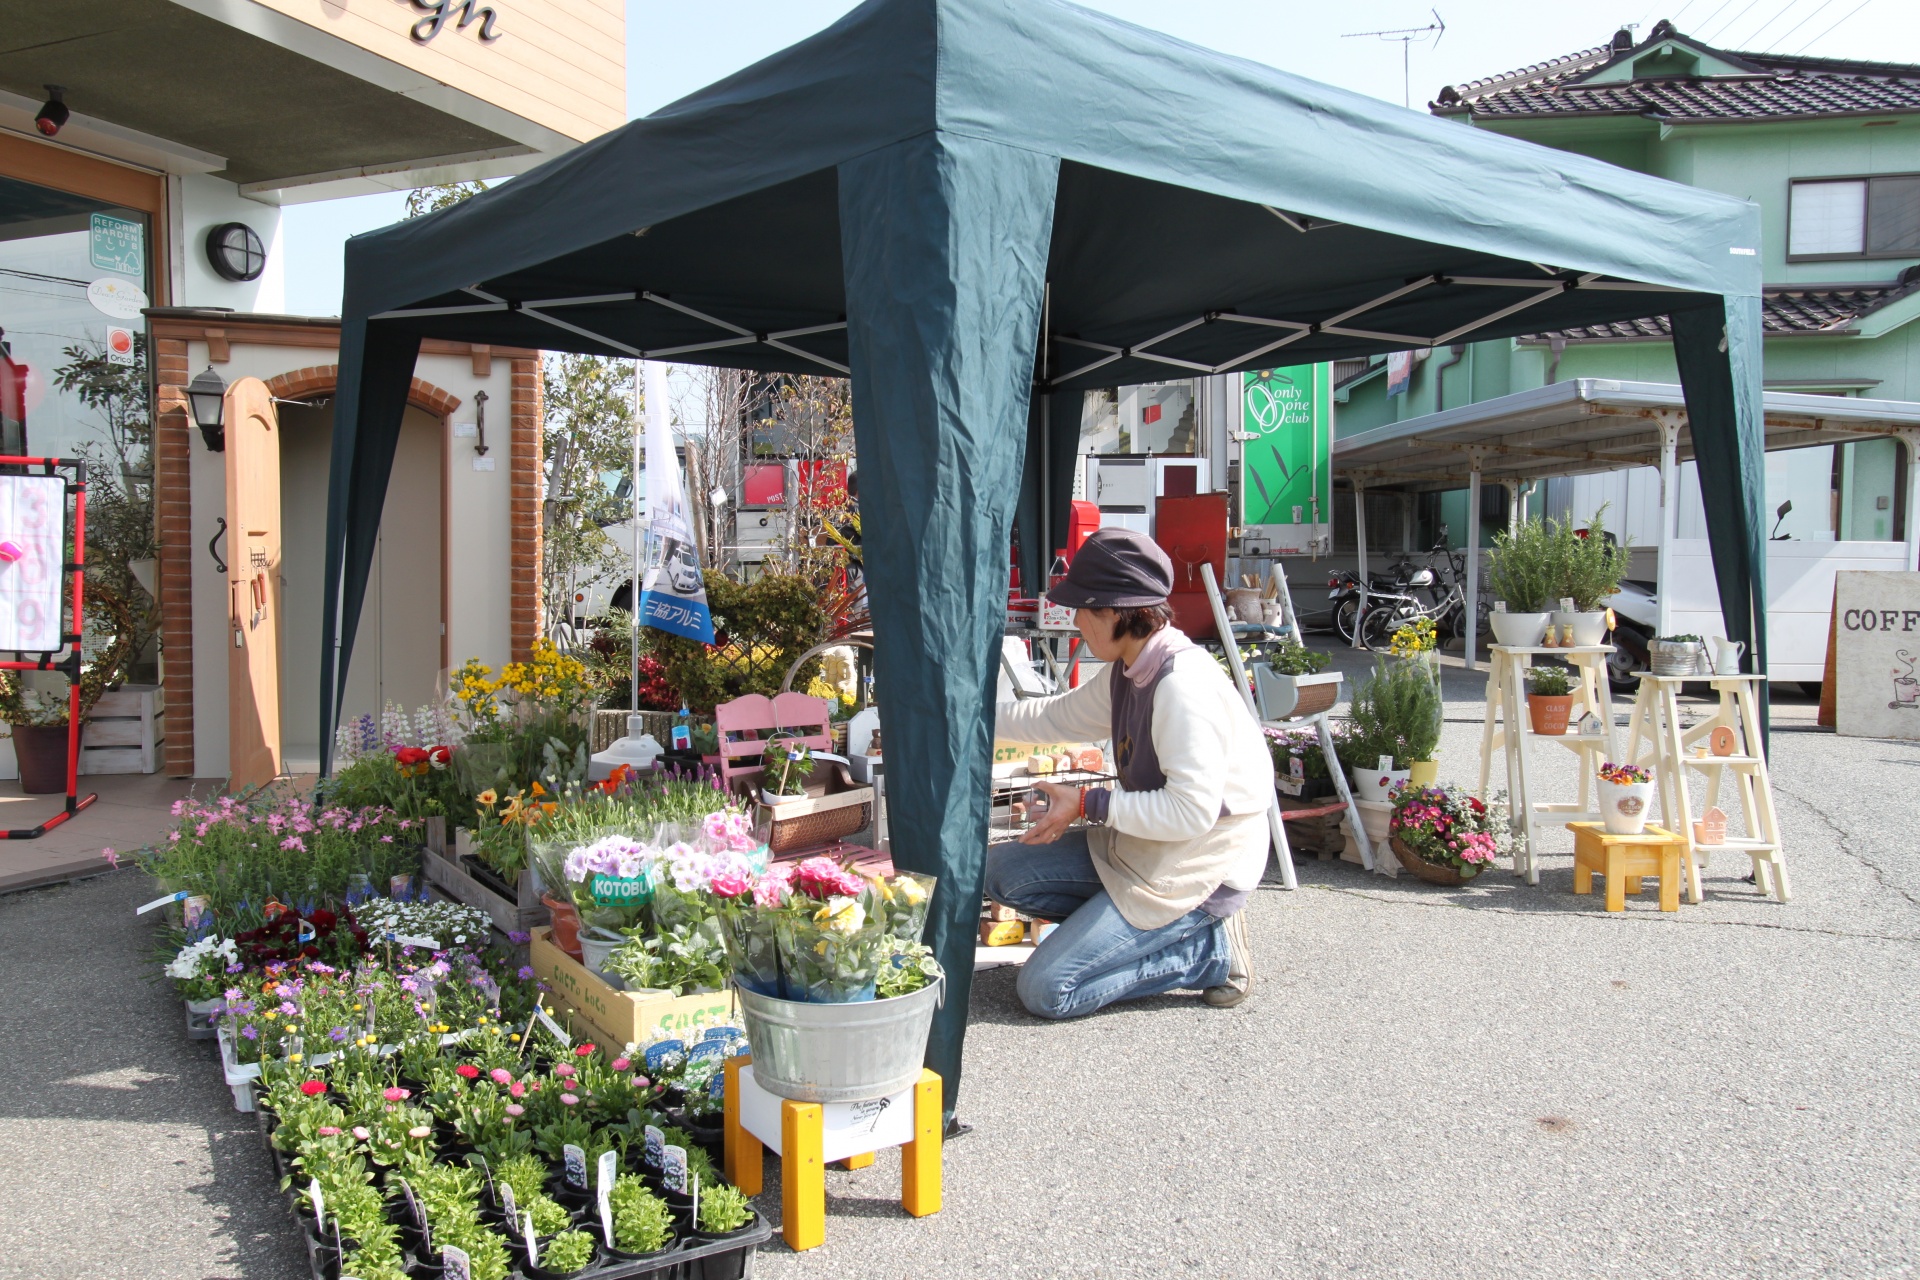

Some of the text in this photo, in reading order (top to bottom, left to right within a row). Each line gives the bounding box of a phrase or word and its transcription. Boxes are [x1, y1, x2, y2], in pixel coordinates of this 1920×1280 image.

[94, 217, 138, 234] REFORM
[94, 226, 138, 242] GARDEN
[94, 234, 138, 250] CLUB
[110, 354, 132, 364] Orico
[1274, 386, 1302, 402] only
[1285, 401, 1310, 411] one
[1285, 412, 1310, 424] club
[766, 492, 784, 503] POST
[21, 486, 46, 529] 3
[18, 598, 44, 640] 9
[645, 599, 702, 630] 三協アルミ
[1843, 609, 1920, 632] COFF
